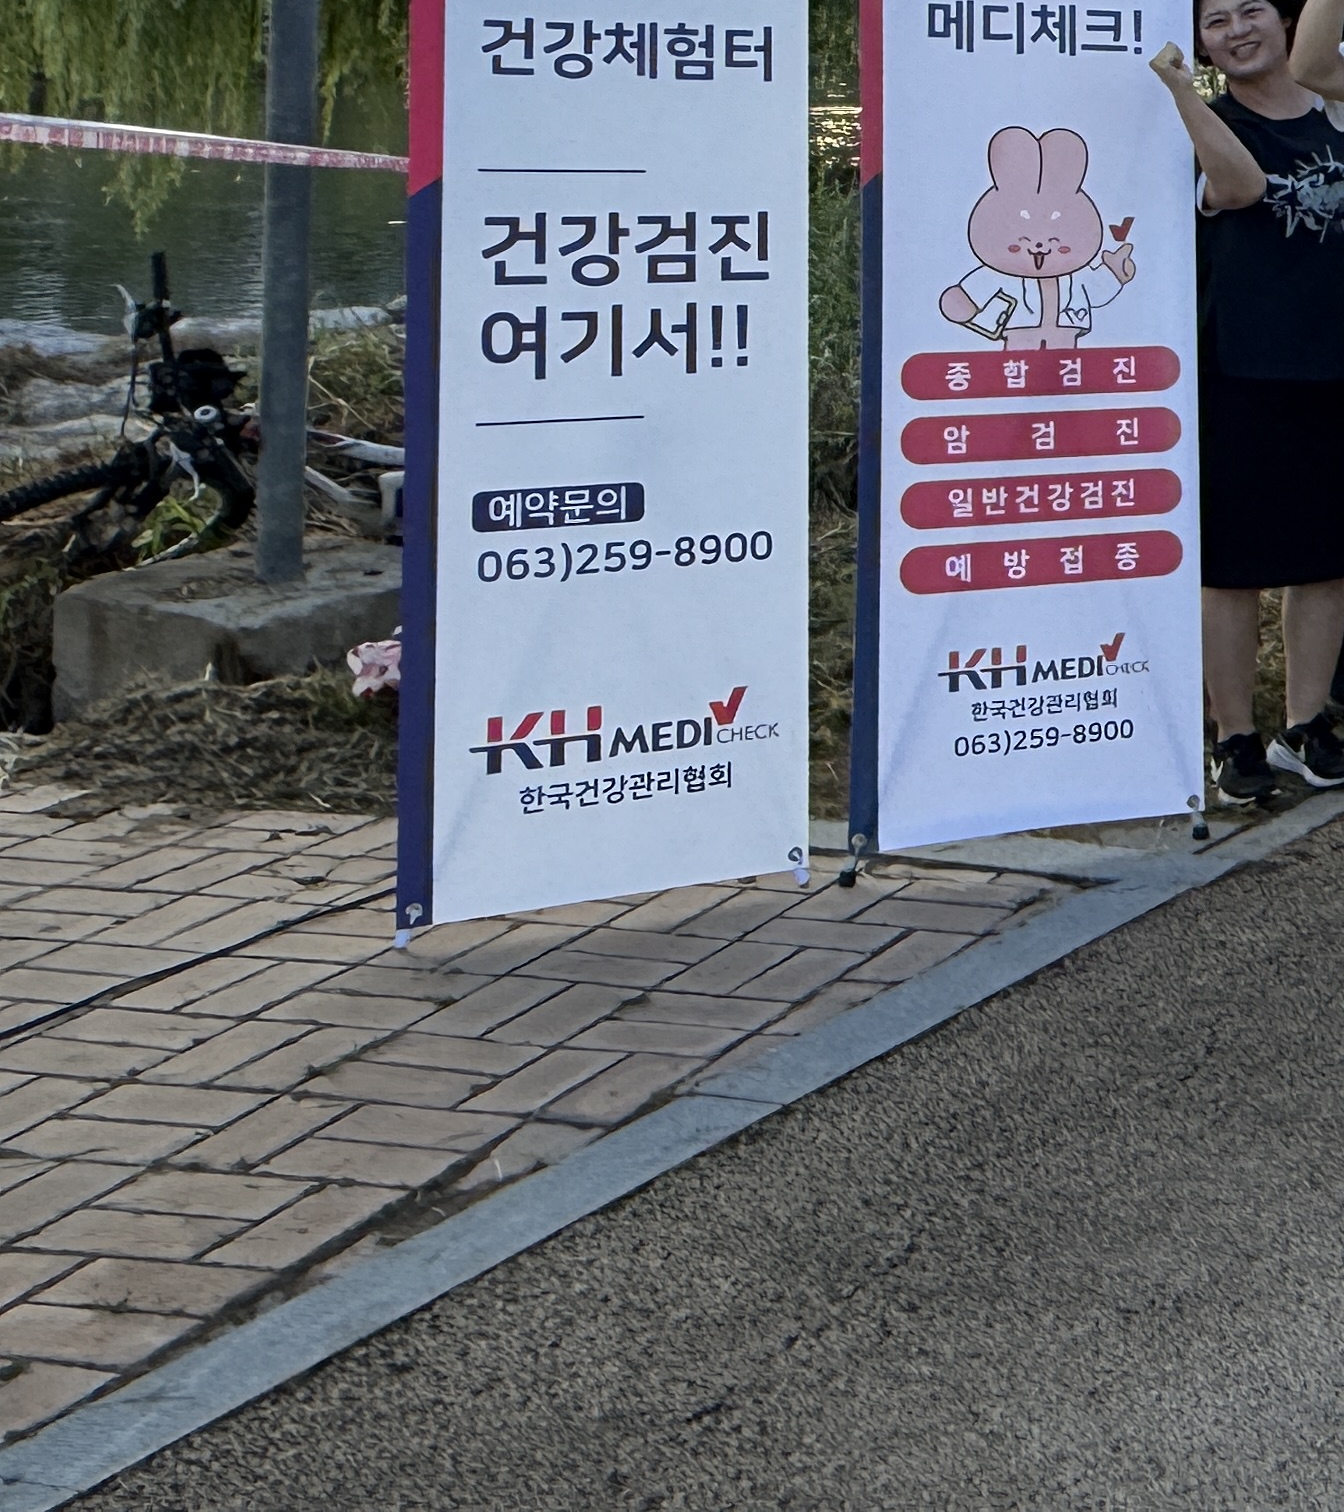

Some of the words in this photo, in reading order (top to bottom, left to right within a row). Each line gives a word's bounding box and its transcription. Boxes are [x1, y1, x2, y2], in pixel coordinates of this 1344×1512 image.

[480, 17, 774, 82] 건강체험터
[927, 0, 1143, 56] 메디체크!
[480, 210, 770, 288] 건강검진
[480, 303, 749, 380] 여기서!!
[488, 486, 627, 528] 예약문의
[947, 480, 1137, 519] 일반건강검진
[477, 530, 774, 582] 063)259-8900
[971, 687, 1119, 722] 한국건강관리협회
[954, 718, 1135, 757] 063)259-8900
[518, 761, 733, 814] 한국건강관리협회
